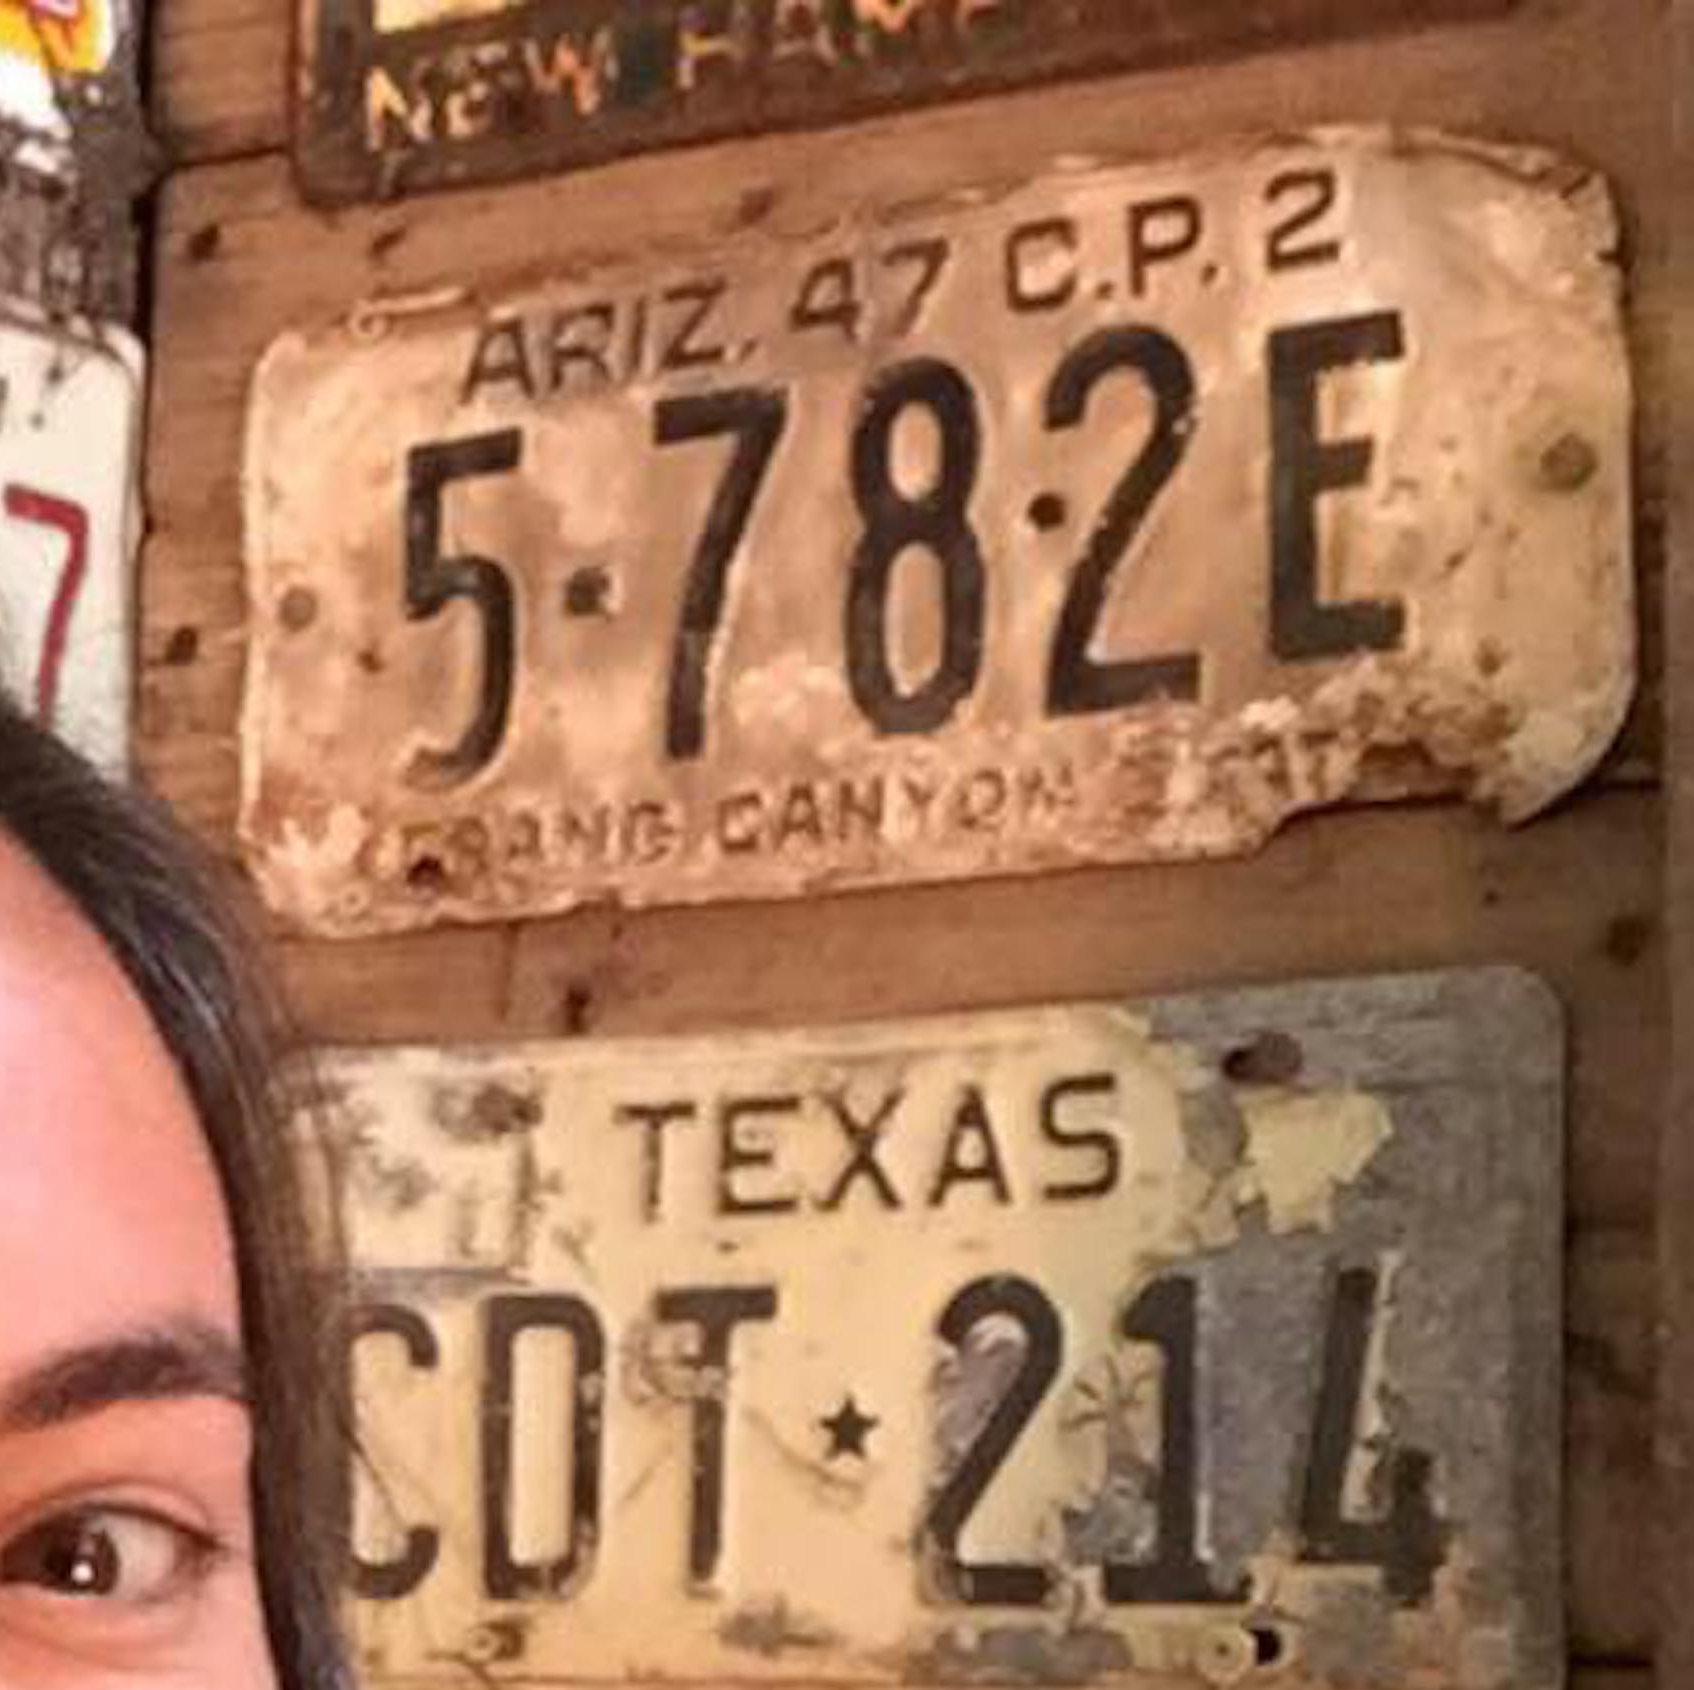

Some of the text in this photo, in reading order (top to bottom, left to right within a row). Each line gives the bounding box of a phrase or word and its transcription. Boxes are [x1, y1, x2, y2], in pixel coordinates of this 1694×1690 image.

[789, 236, 951, 342] 47
[1264, 168, 1341, 272] 2
[716, 762, 1074, 856] CANYON
[612, 1069, 1124, 1219] TEXAS
[340, 1264, 1452, 1606] CDT 214
